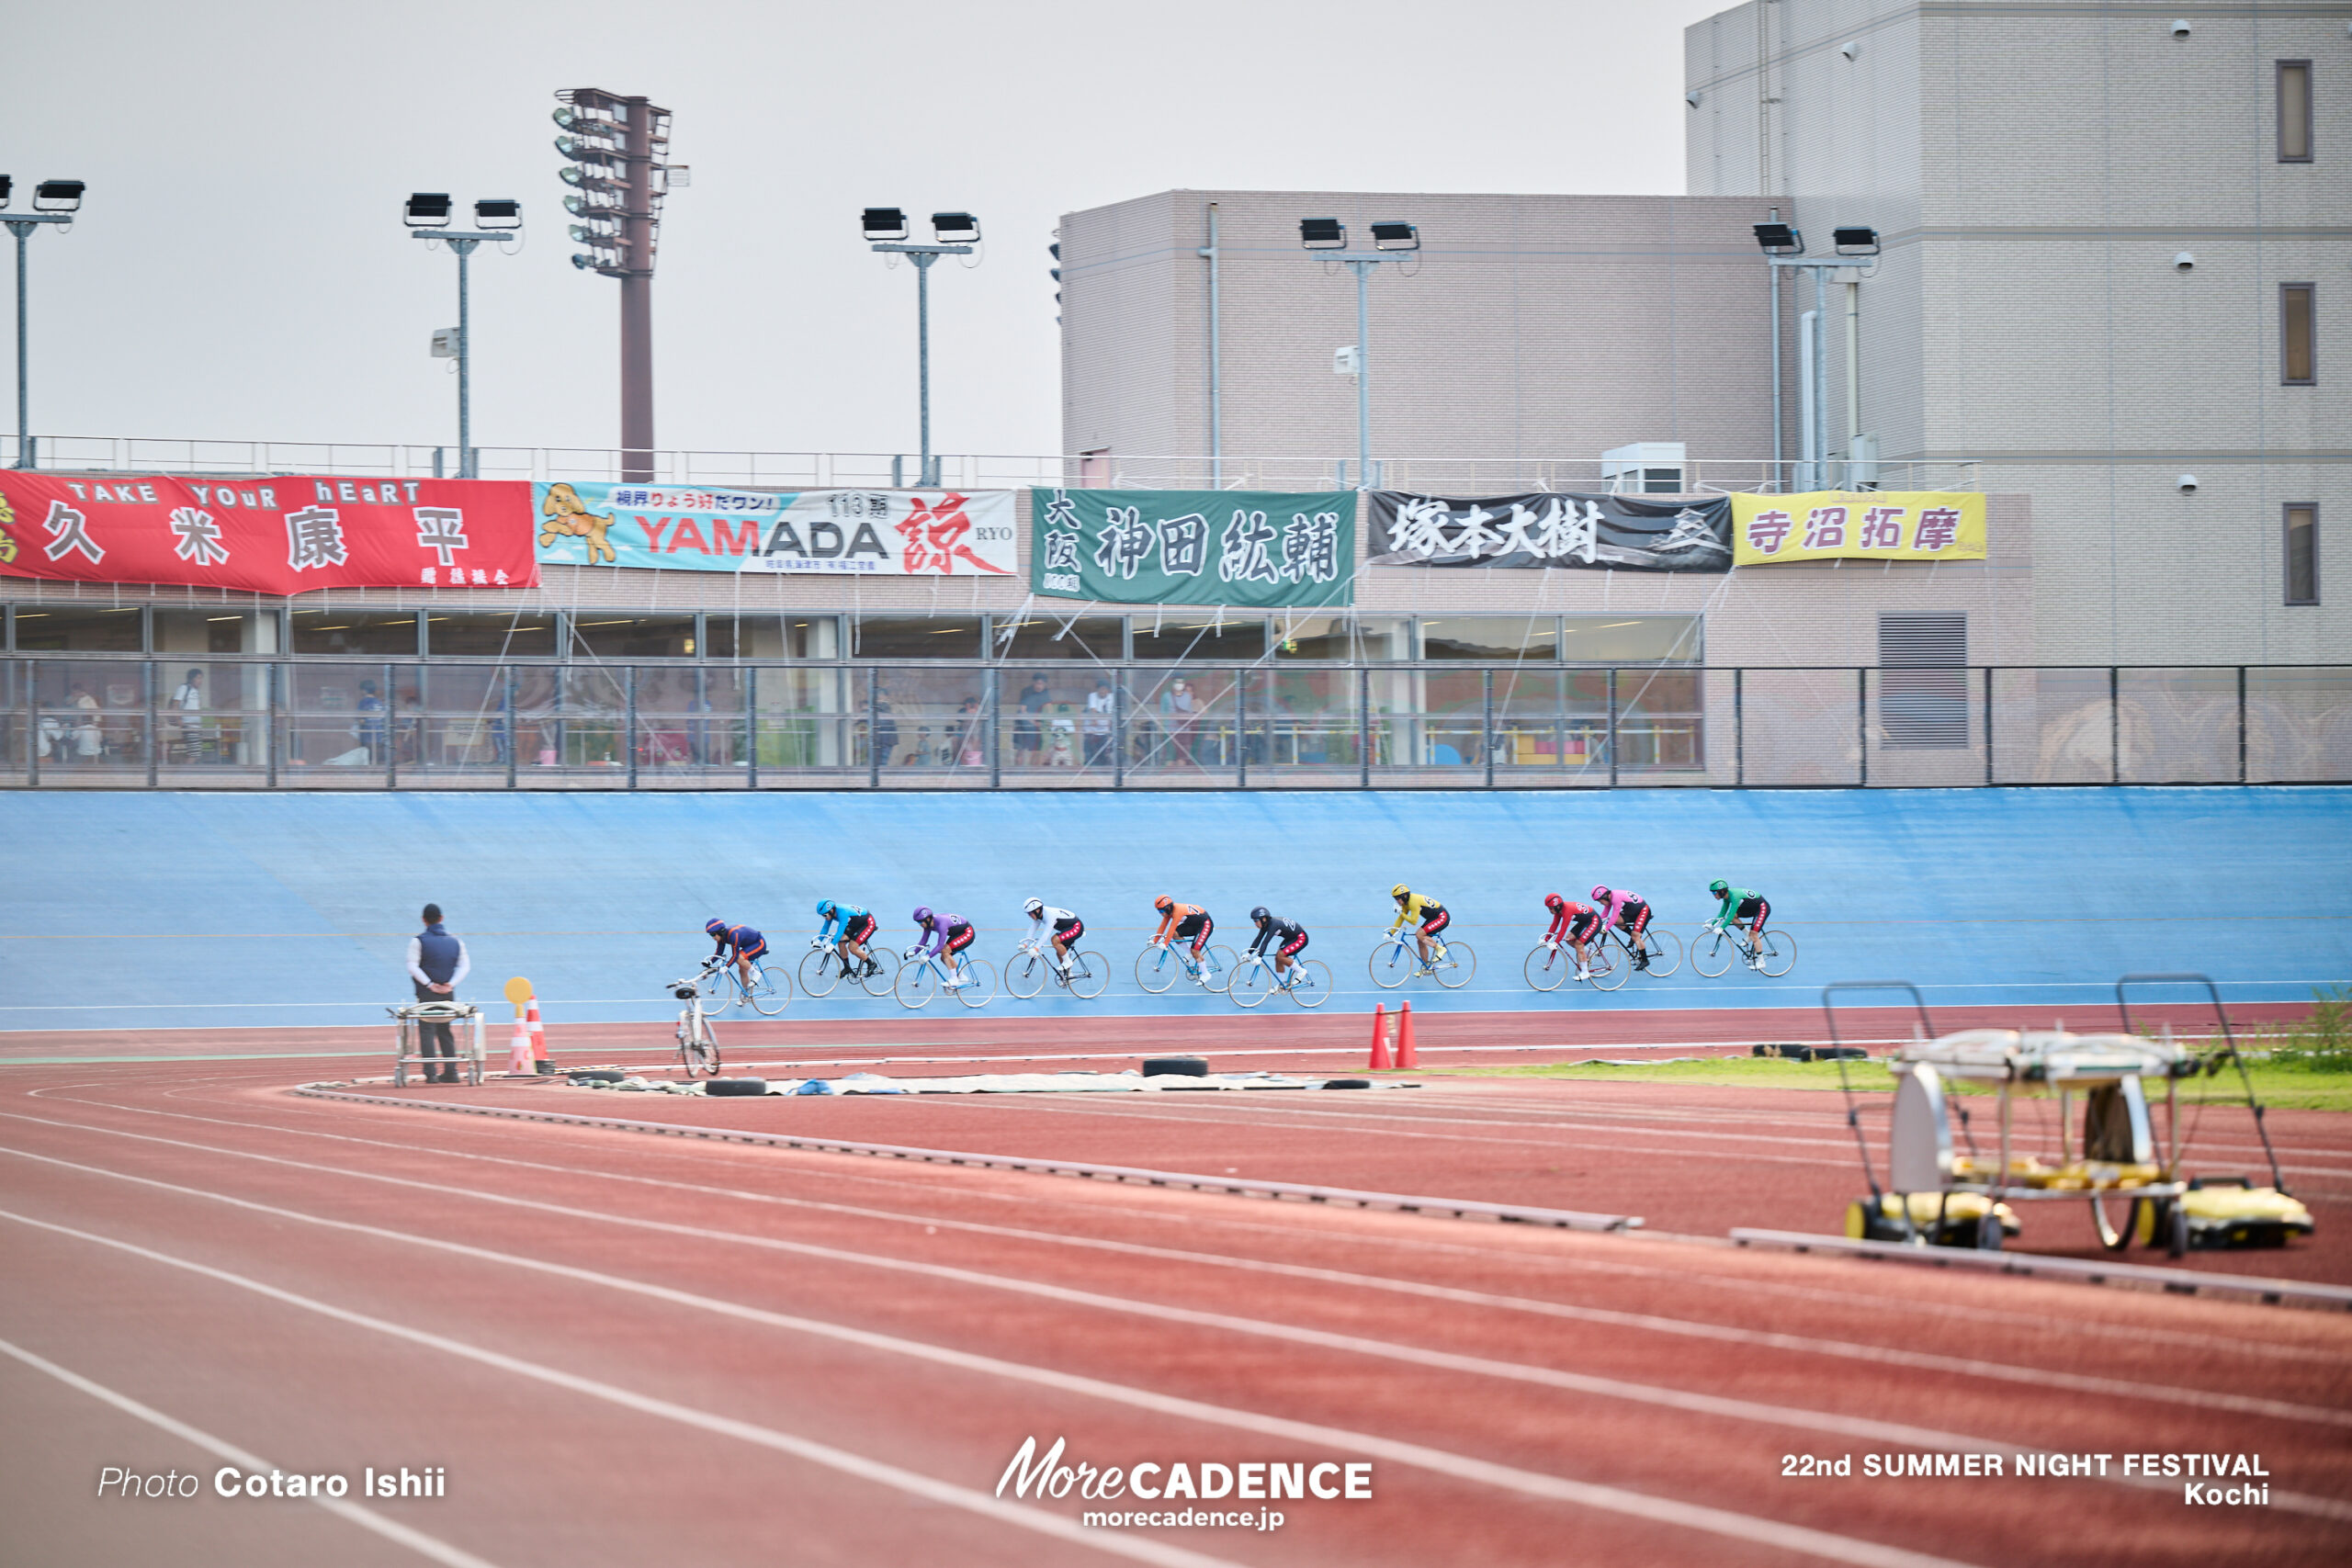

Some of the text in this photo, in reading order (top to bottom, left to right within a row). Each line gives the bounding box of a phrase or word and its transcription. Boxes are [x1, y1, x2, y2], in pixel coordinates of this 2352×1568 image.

[66, 482, 161, 504] TAKE
[42, 500, 469, 571] 久米康平
[633, 515, 890, 560] YAMADA
[976, 527, 1012, 540] RYO
[1044, 489, 1082, 573] 大阪
[1387, 498, 1605, 564] 塚本大樹
[1747, 507, 1962, 555] 寺沼拓摩
[1283, 917, 1296, 931] 2
[1576, 902, 1589, 915] 3
